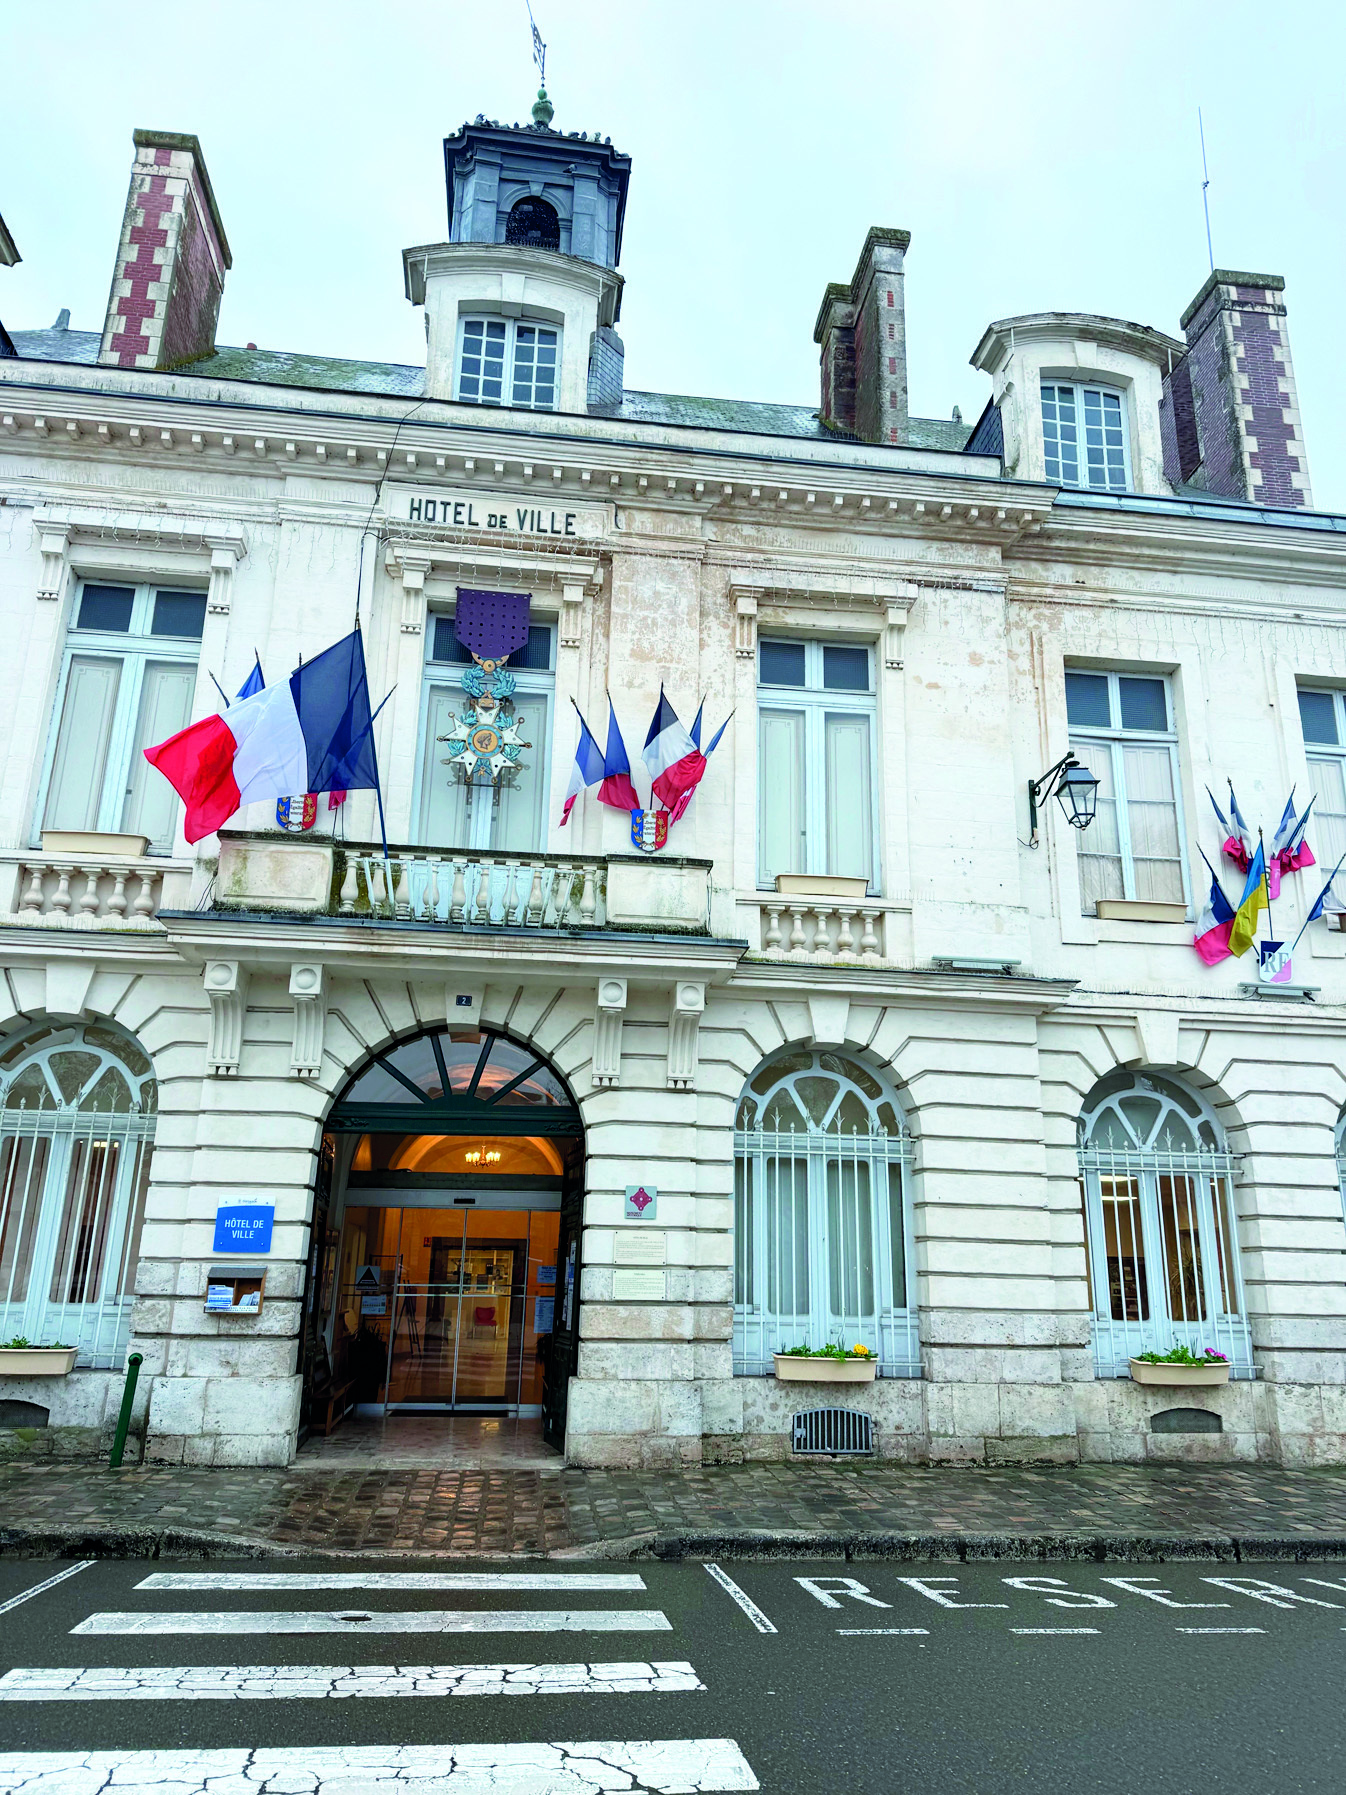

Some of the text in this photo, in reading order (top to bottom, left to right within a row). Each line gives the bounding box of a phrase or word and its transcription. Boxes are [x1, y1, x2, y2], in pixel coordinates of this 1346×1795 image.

[409, 498, 577, 536] HOTEL DE VILLE
[1263, 951, 1290, 973] RF
[224, 1217, 264, 1239] HÔTEL DE VILLE
